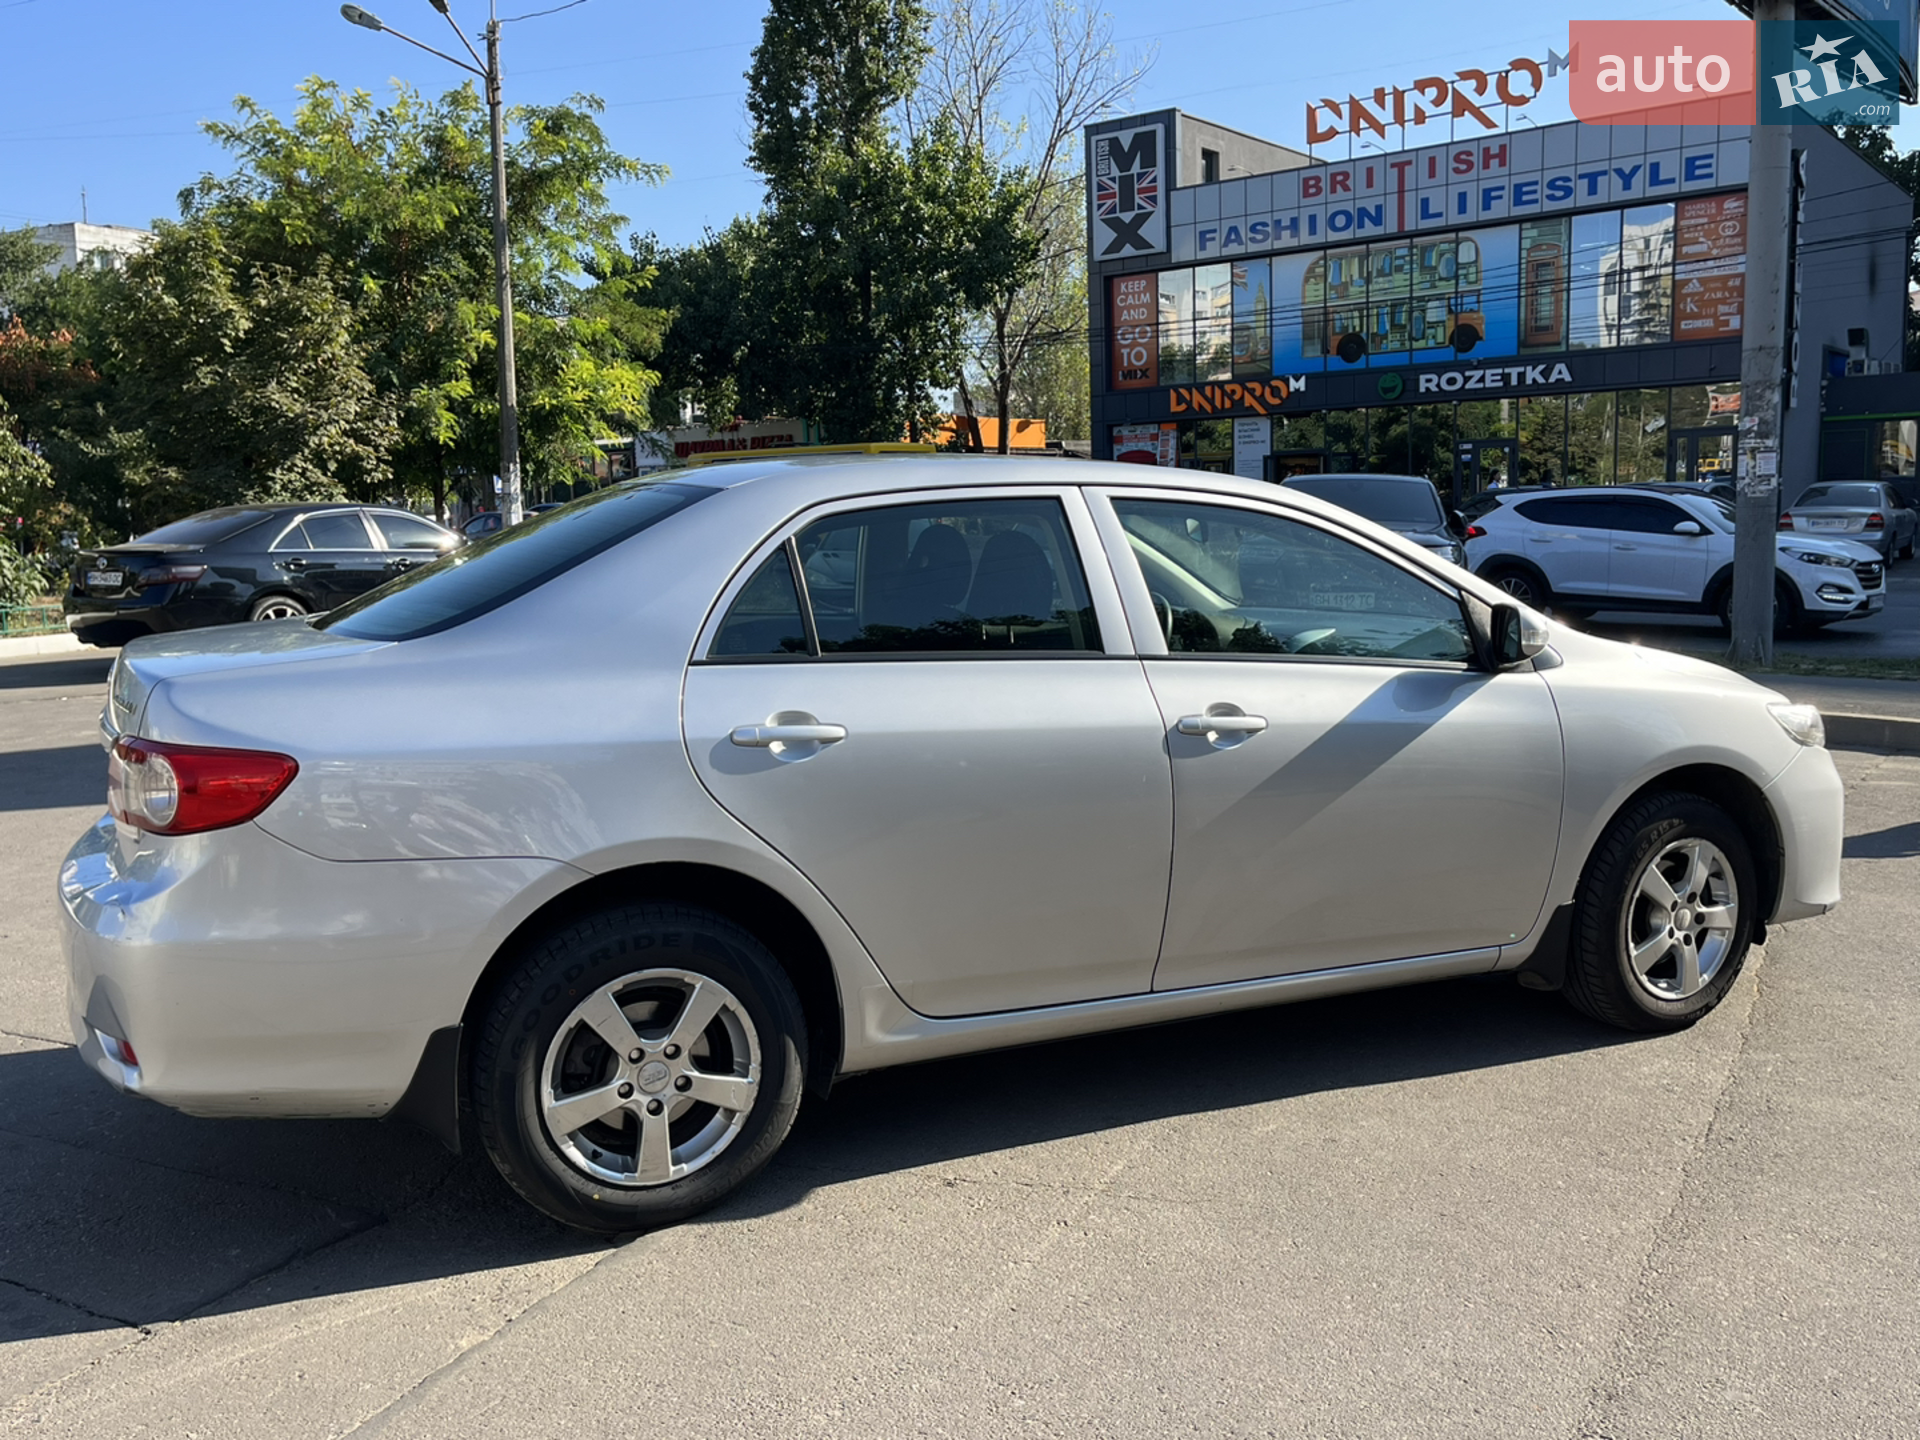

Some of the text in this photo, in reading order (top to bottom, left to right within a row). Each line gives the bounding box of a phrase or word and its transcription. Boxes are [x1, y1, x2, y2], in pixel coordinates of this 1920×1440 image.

[1096, 140, 1110, 175] BRITISH
[1099, 129, 1157, 256] MIX
[1302, 144, 1507, 232] BRITISH
[1199, 153, 1715, 251] FASHION LIFESTYLE
[1120, 279, 1147, 293] KEEP
[1704, 291, 1730, 300] ZARA
[1117, 292, 1151, 306] CALM
[1121, 307, 1147, 321] AND
[1117, 325, 1152, 344] GO
[1121, 346, 1147, 366] TO
[1119, 367, 1150, 381] MIX
[1419, 362, 1573, 393] ROZETKA
